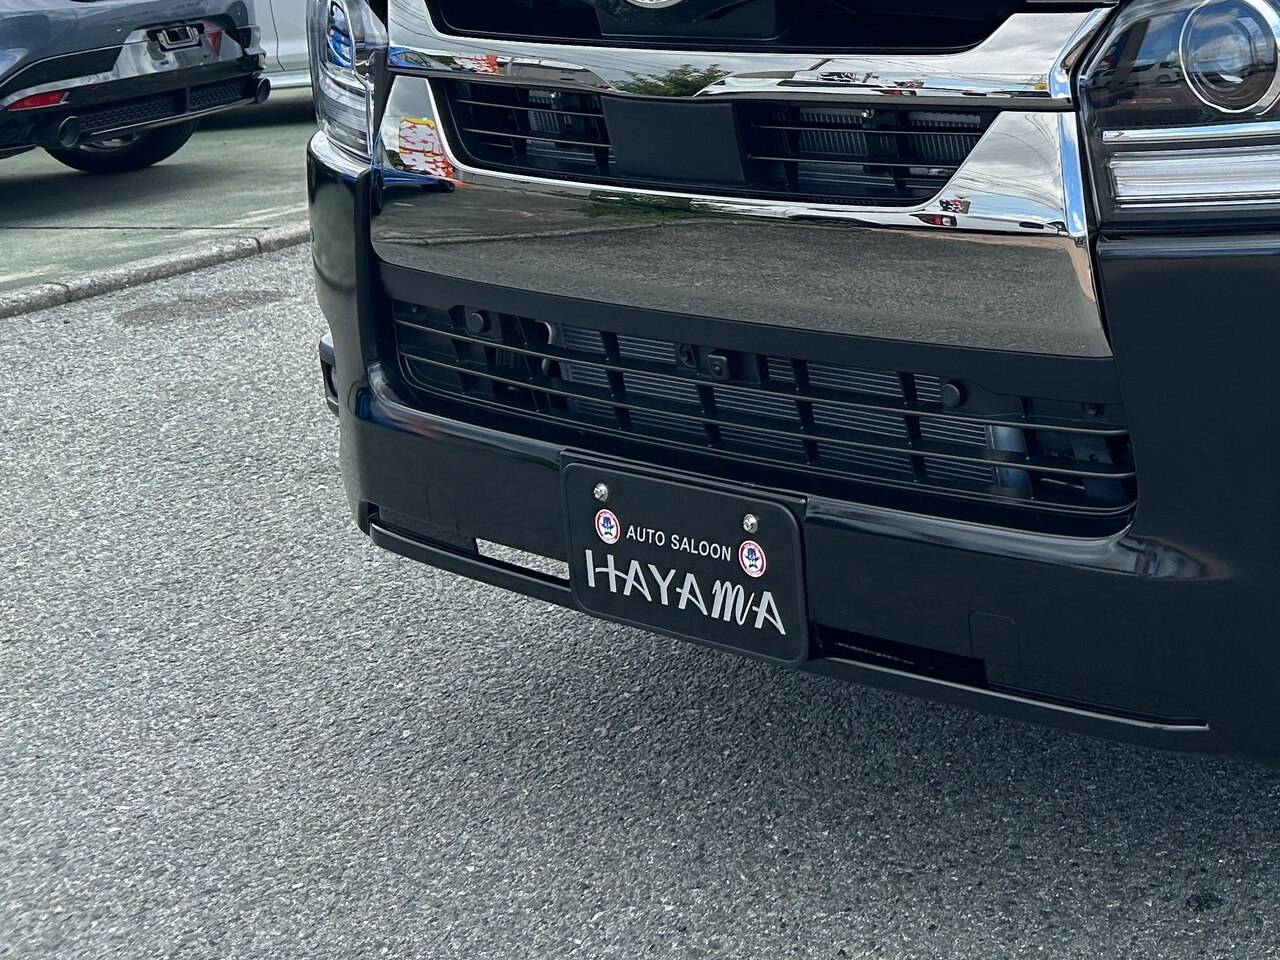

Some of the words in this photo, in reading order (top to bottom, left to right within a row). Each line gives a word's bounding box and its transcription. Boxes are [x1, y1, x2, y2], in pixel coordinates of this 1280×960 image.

[626, 524, 665, 546] AUTO
[670, 534, 732, 562] SALOON
[585, 549, 786, 635] HAYAMA
